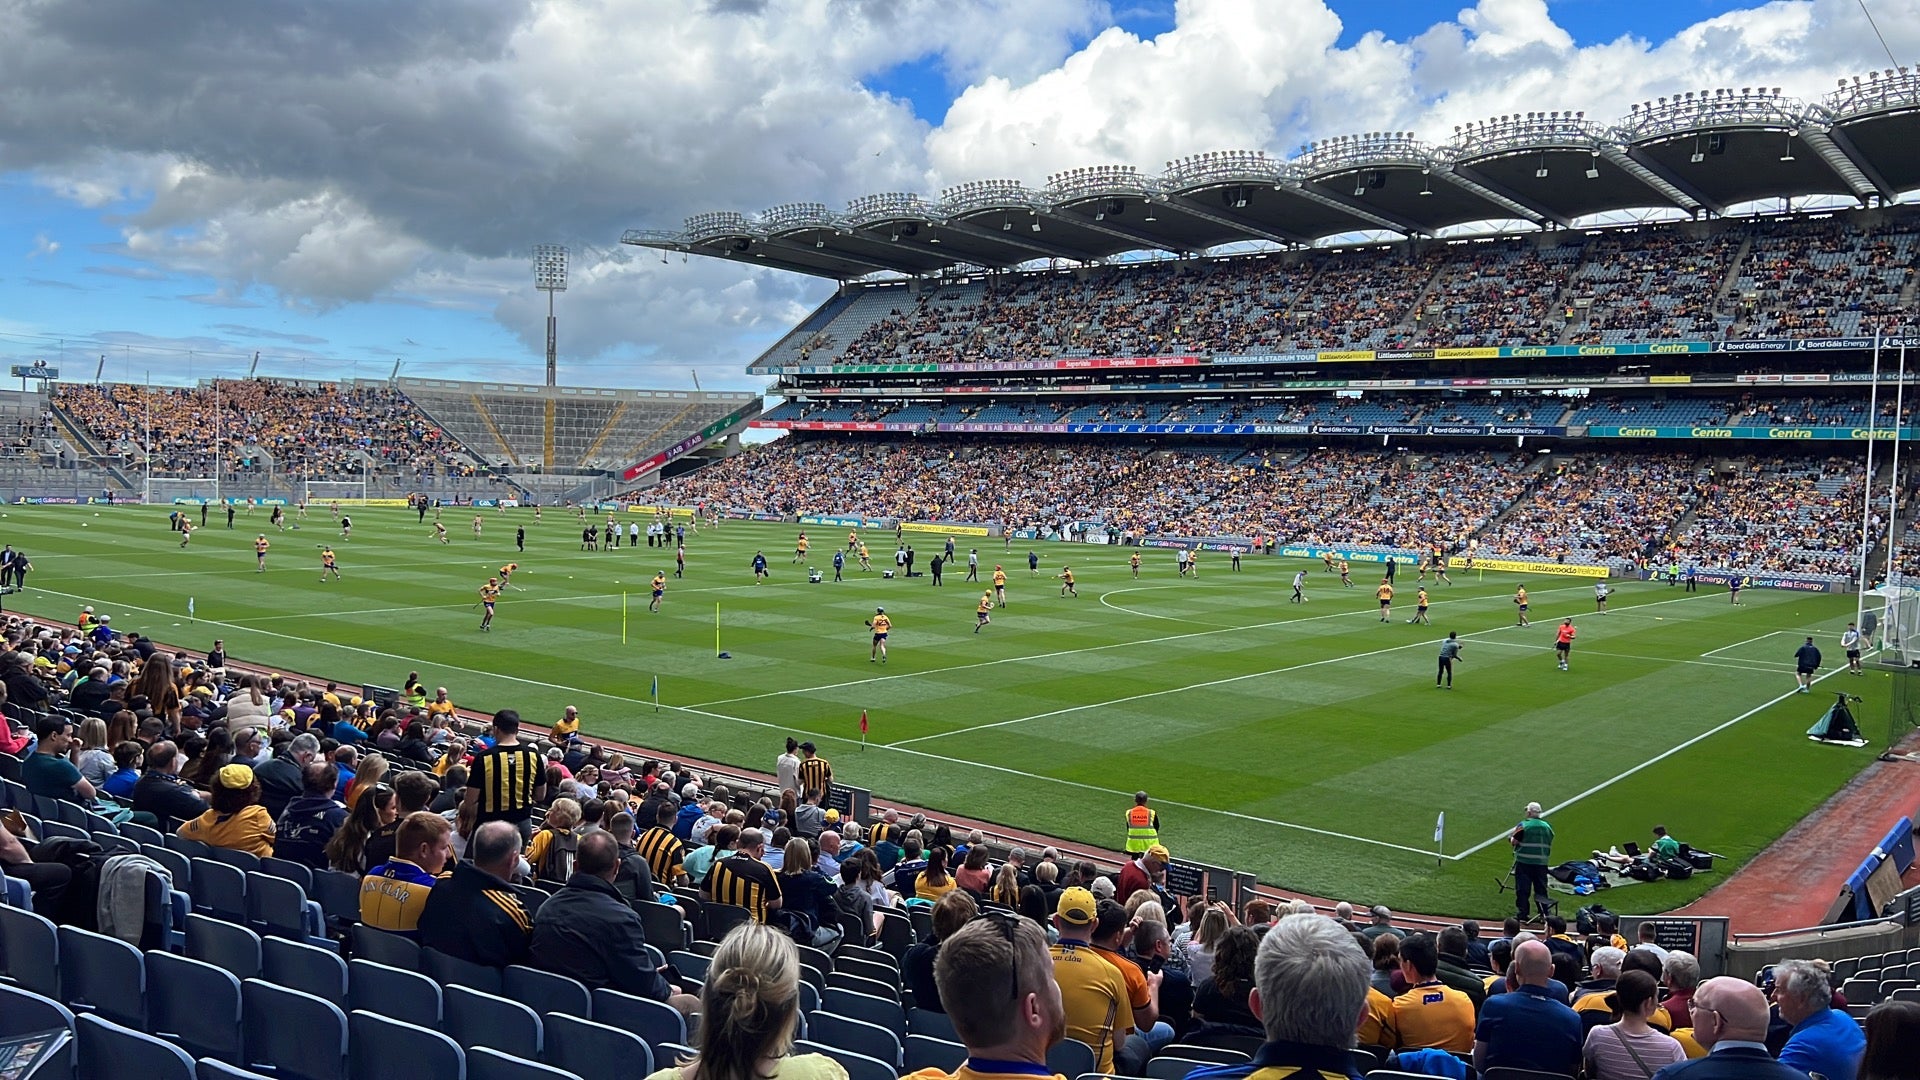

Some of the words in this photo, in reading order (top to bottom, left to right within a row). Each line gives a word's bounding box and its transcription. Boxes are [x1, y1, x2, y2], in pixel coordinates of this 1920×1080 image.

[1650, 344, 1689, 353] Centra
[1761, 342, 1785, 350] Energy
[1843, 340, 1869, 348] Energy
[1511, 348, 1547, 356] Centra
[1578, 346, 1616, 355] Centra
[1618, 427, 1656, 436] Centra
[1692, 428, 1732, 437] Centra
[1769, 428, 1812, 438] Centra
[692, 435, 702, 445] AIB
[673, 446, 683, 455] AIB
[635, 460, 655, 473] SuperValu
[1283, 549, 1309, 557] Centra
[1350, 552, 1378, 561] Centra
[1528, 564, 1577, 574] Littlewoods
[1577, 567, 1606, 576] Ireland
[1698, 575, 1726, 584] Energy
[1774, 578, 1792, 588] Gáis
[1794, 581, 1824, 591] Energy
